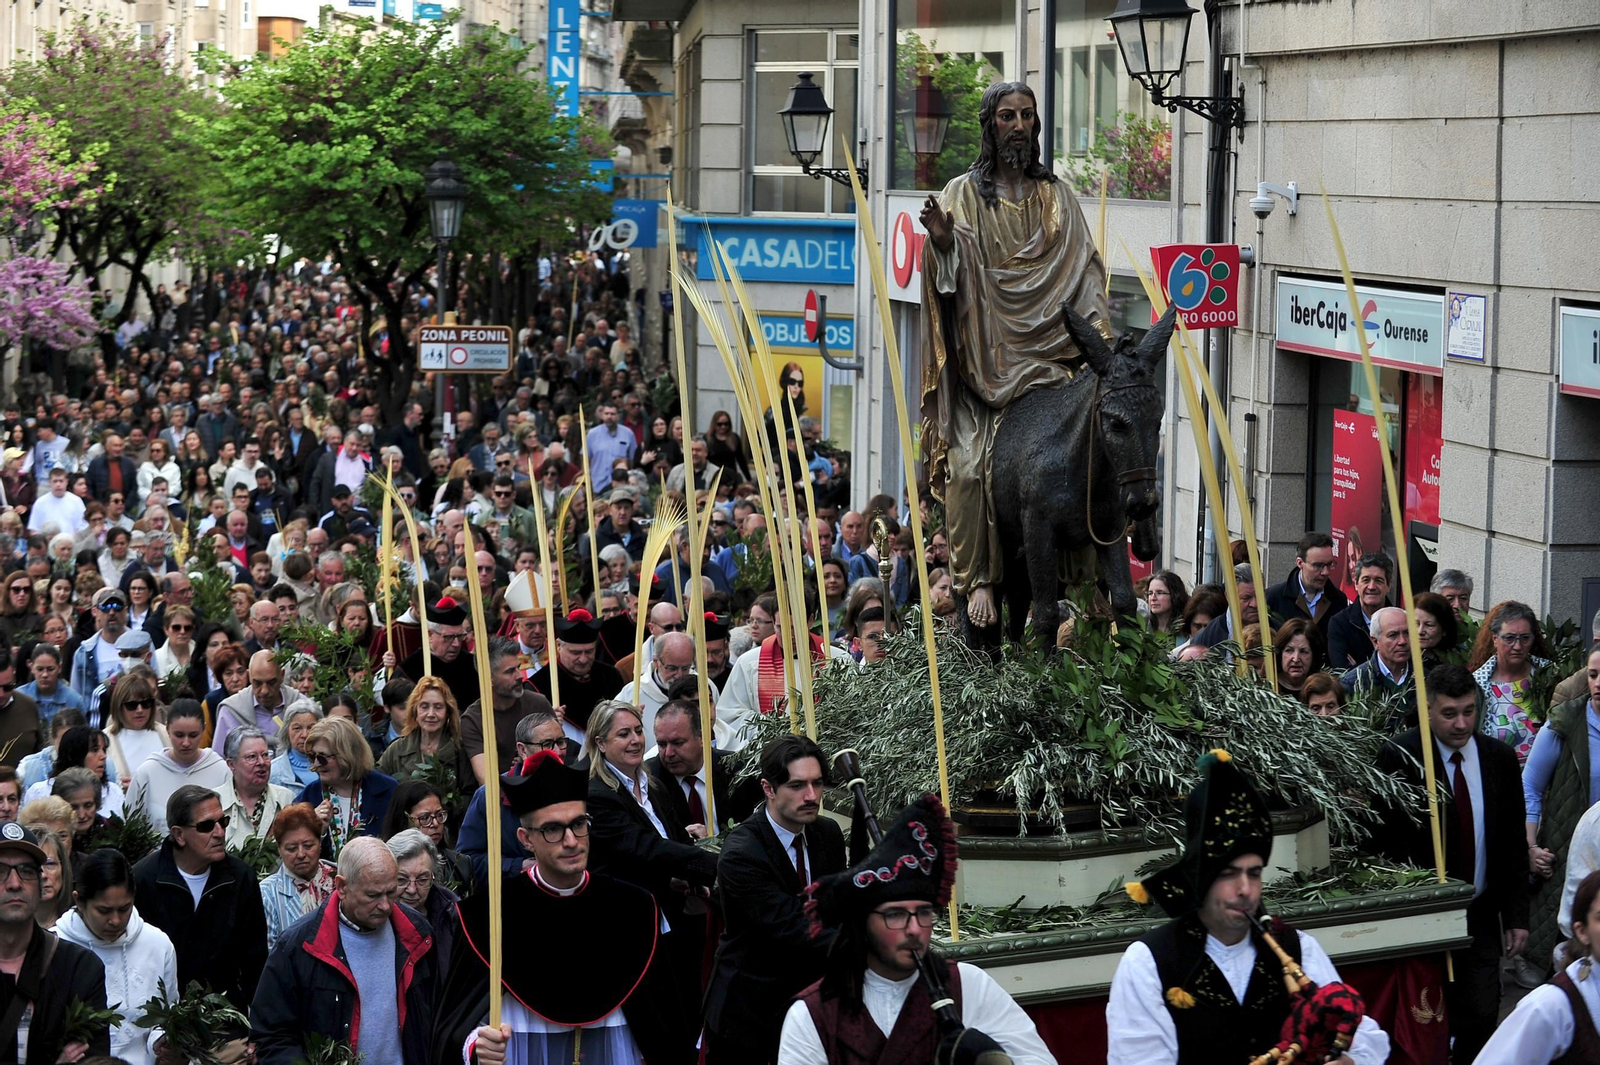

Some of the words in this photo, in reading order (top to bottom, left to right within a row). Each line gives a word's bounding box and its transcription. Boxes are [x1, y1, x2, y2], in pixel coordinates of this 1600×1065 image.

[722, 237, 856, 271] CASADEL
[1201, 310, 1236, 323] 6000
[1290, 295, 1347, 338] iberCaja
[1384, 318, 1429, 343] Ourense
[421, 329, 457, 342] ZONA
[460, 330, 509, 342] PEONIL
[762, 322, 851, 347] OBJEOS
[1333, 454, 1350, 465] Libertad
[1333, 467, 1343, 475] para
[1333, 477, 1356, 490] tranquilidad
[1333, 490, 1342, 498] para
